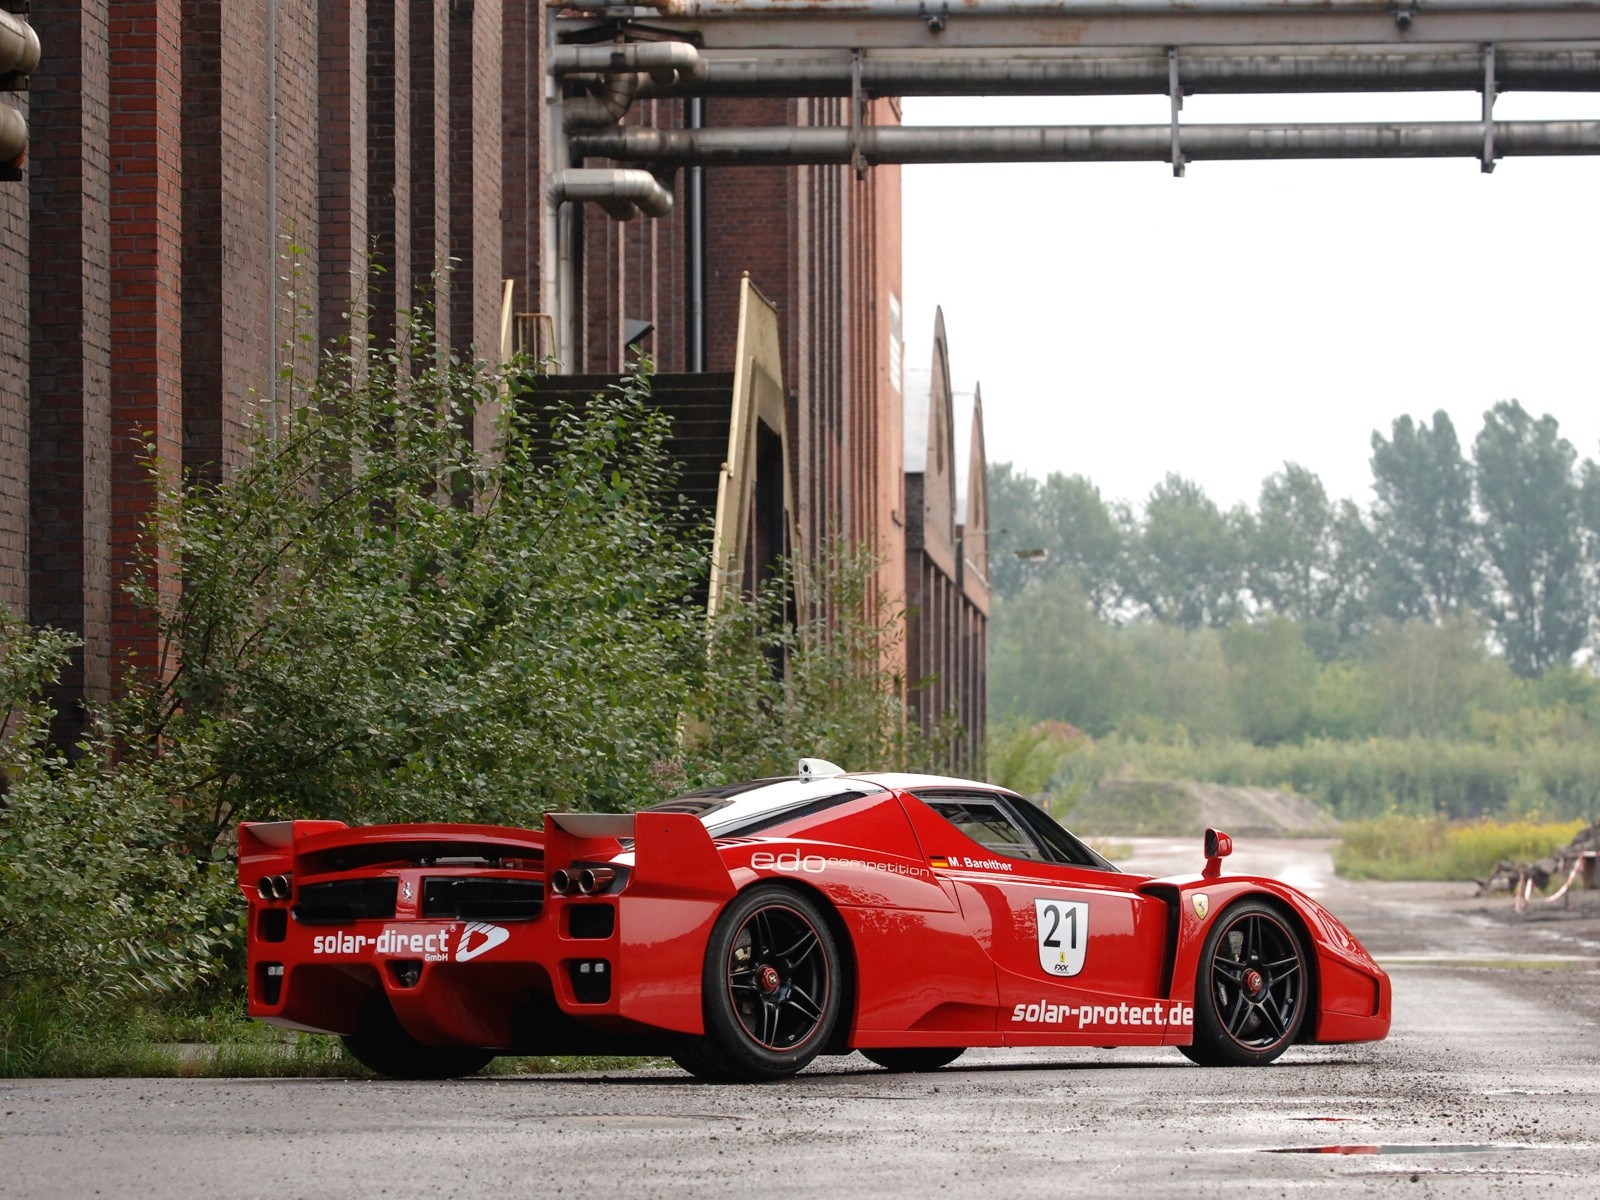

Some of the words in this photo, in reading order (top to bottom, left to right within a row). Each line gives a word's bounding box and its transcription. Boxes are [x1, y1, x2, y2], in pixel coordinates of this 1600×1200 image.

[750, 848, 827, 873] edo
[828, 855, 930, 878] competition
[948, 856, 963, 868] M.
[965, 857, 1013, 872] Bareither
[1043, 904, 1077, 949] 21
[313, 929, 449, 955] solar-direct
[424, 953, 448, 962] GmbH
[1011, 999, 1194, 1029] solar-protect.de
